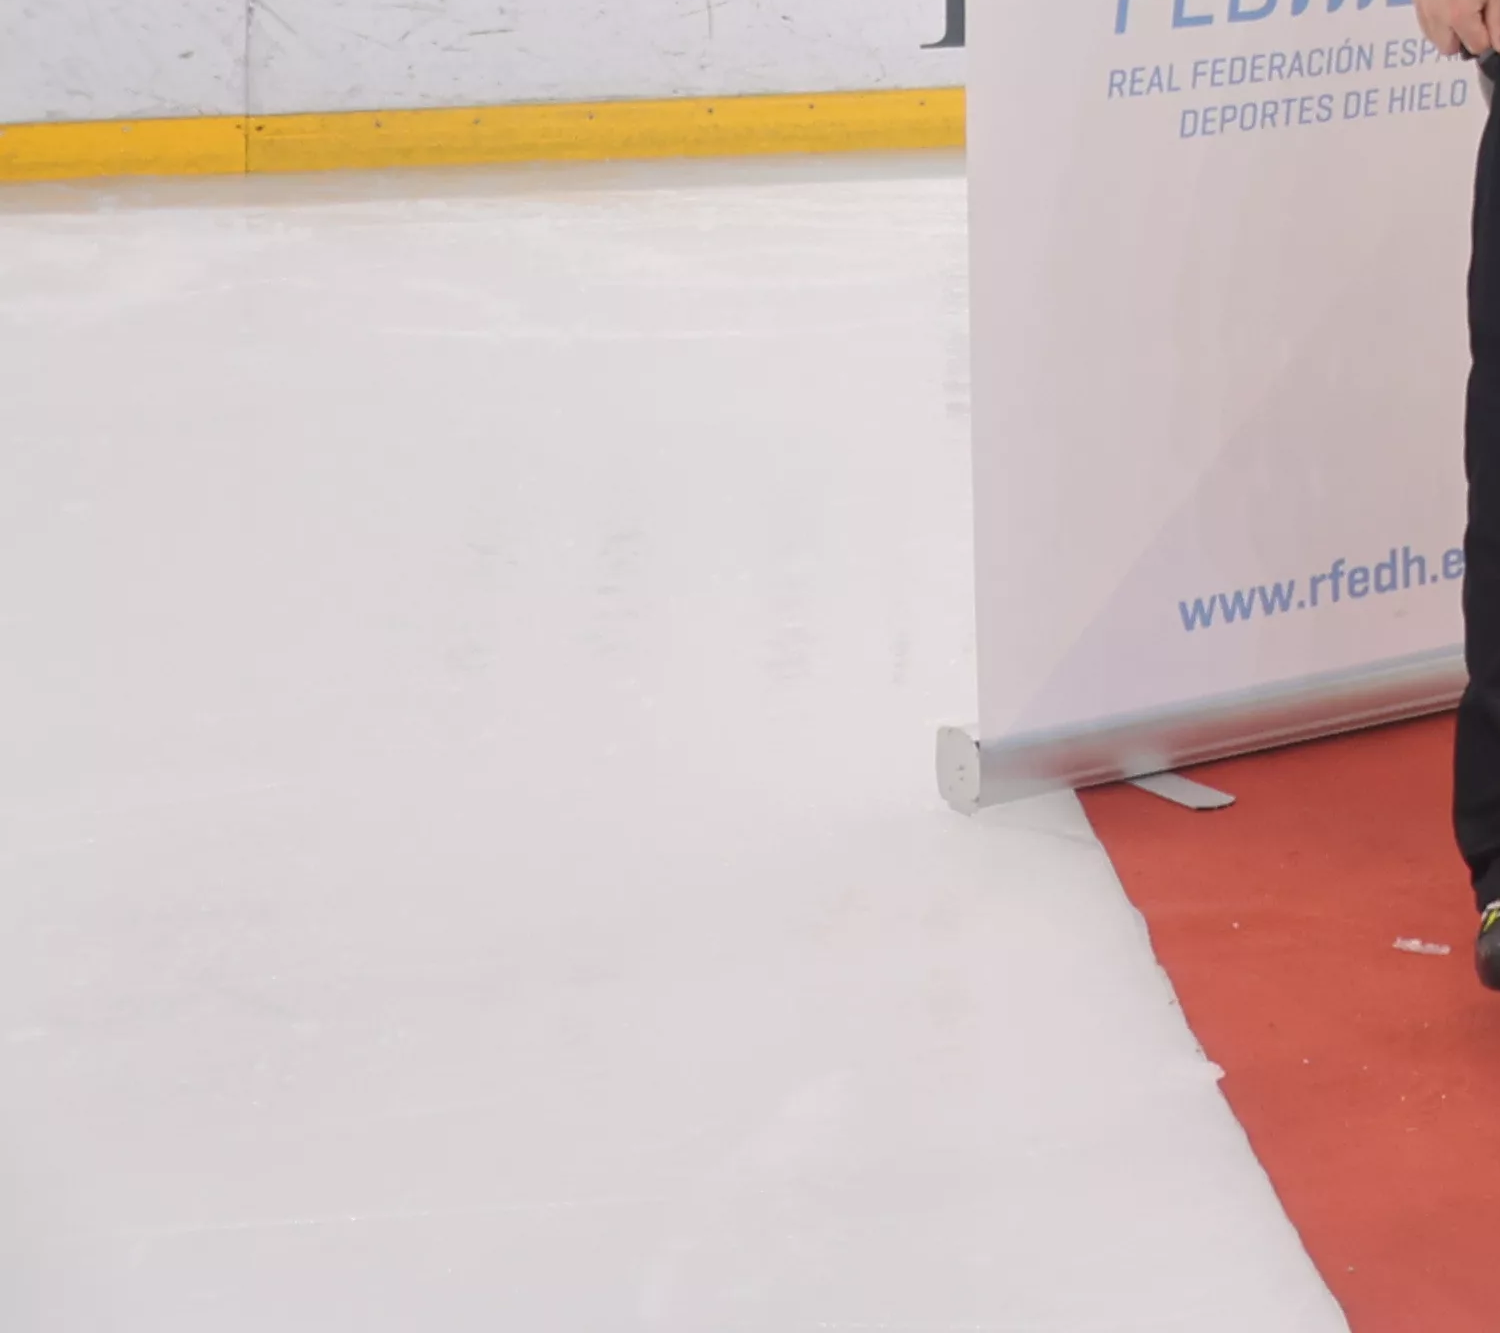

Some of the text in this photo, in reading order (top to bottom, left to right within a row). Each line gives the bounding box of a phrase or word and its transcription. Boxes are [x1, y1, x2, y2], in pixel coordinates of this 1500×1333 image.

[1107, 60, 1181, 100] REAL
[1191, 37, 1375, 91] FEDERACIÓN
[1179, 78, 1468, 139] DEPORTES DE HIELO
